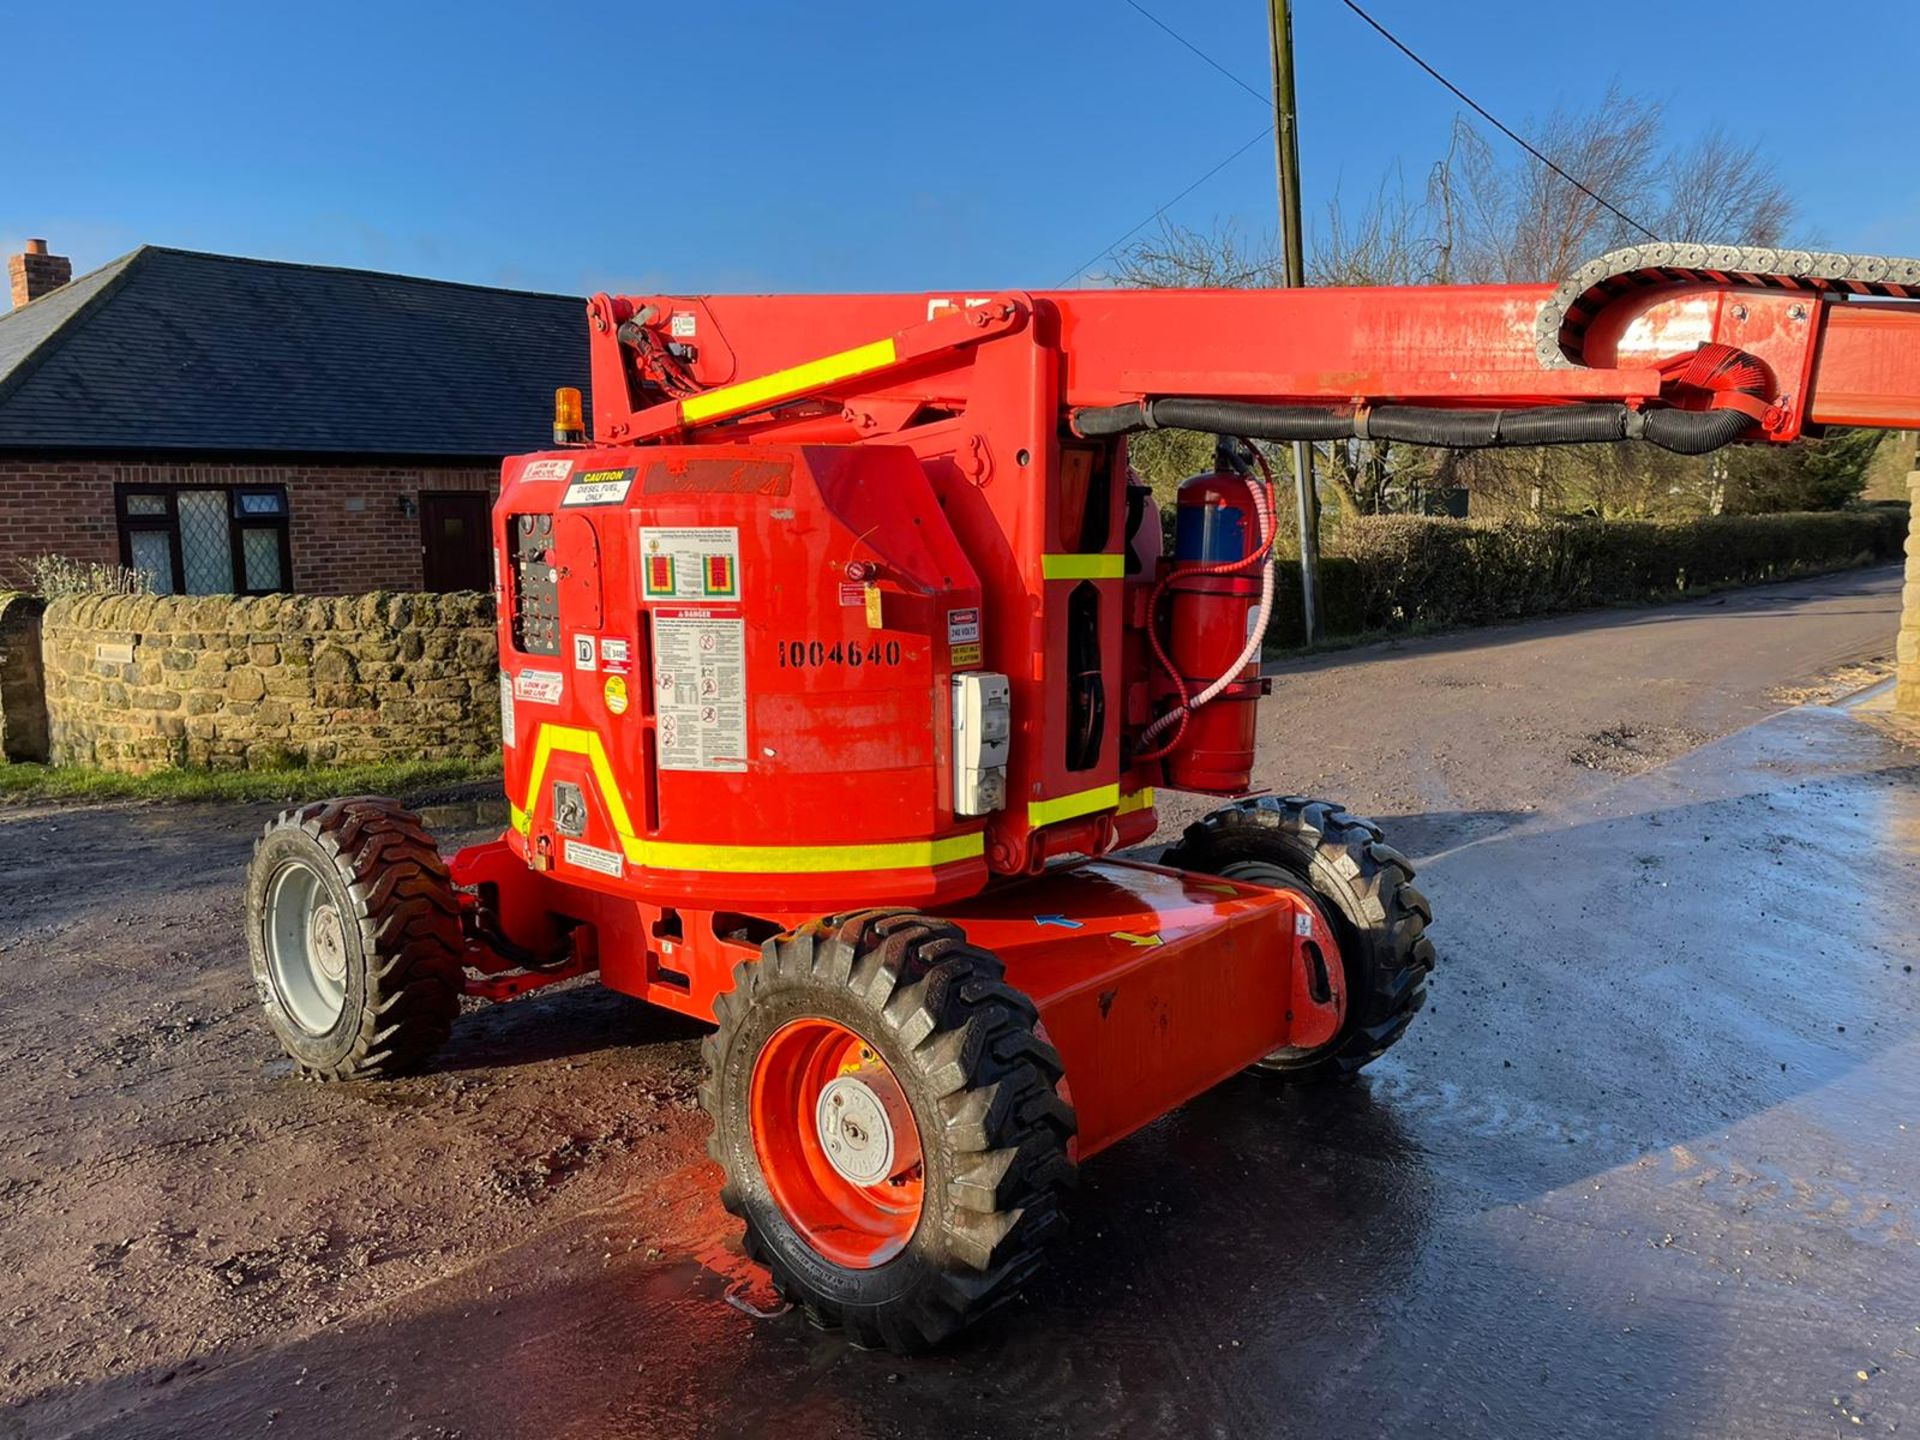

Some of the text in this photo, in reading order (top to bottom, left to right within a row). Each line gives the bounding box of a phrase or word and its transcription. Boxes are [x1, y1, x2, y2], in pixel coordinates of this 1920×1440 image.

[583, 470, 624, 482] CAUTION
[576, 485, 599, 494] DIESEL
[585, 493, 603, 501] ONLY
[684, 610, 711, 618] DANGER
[778, 640, 901, 668] 1004640
